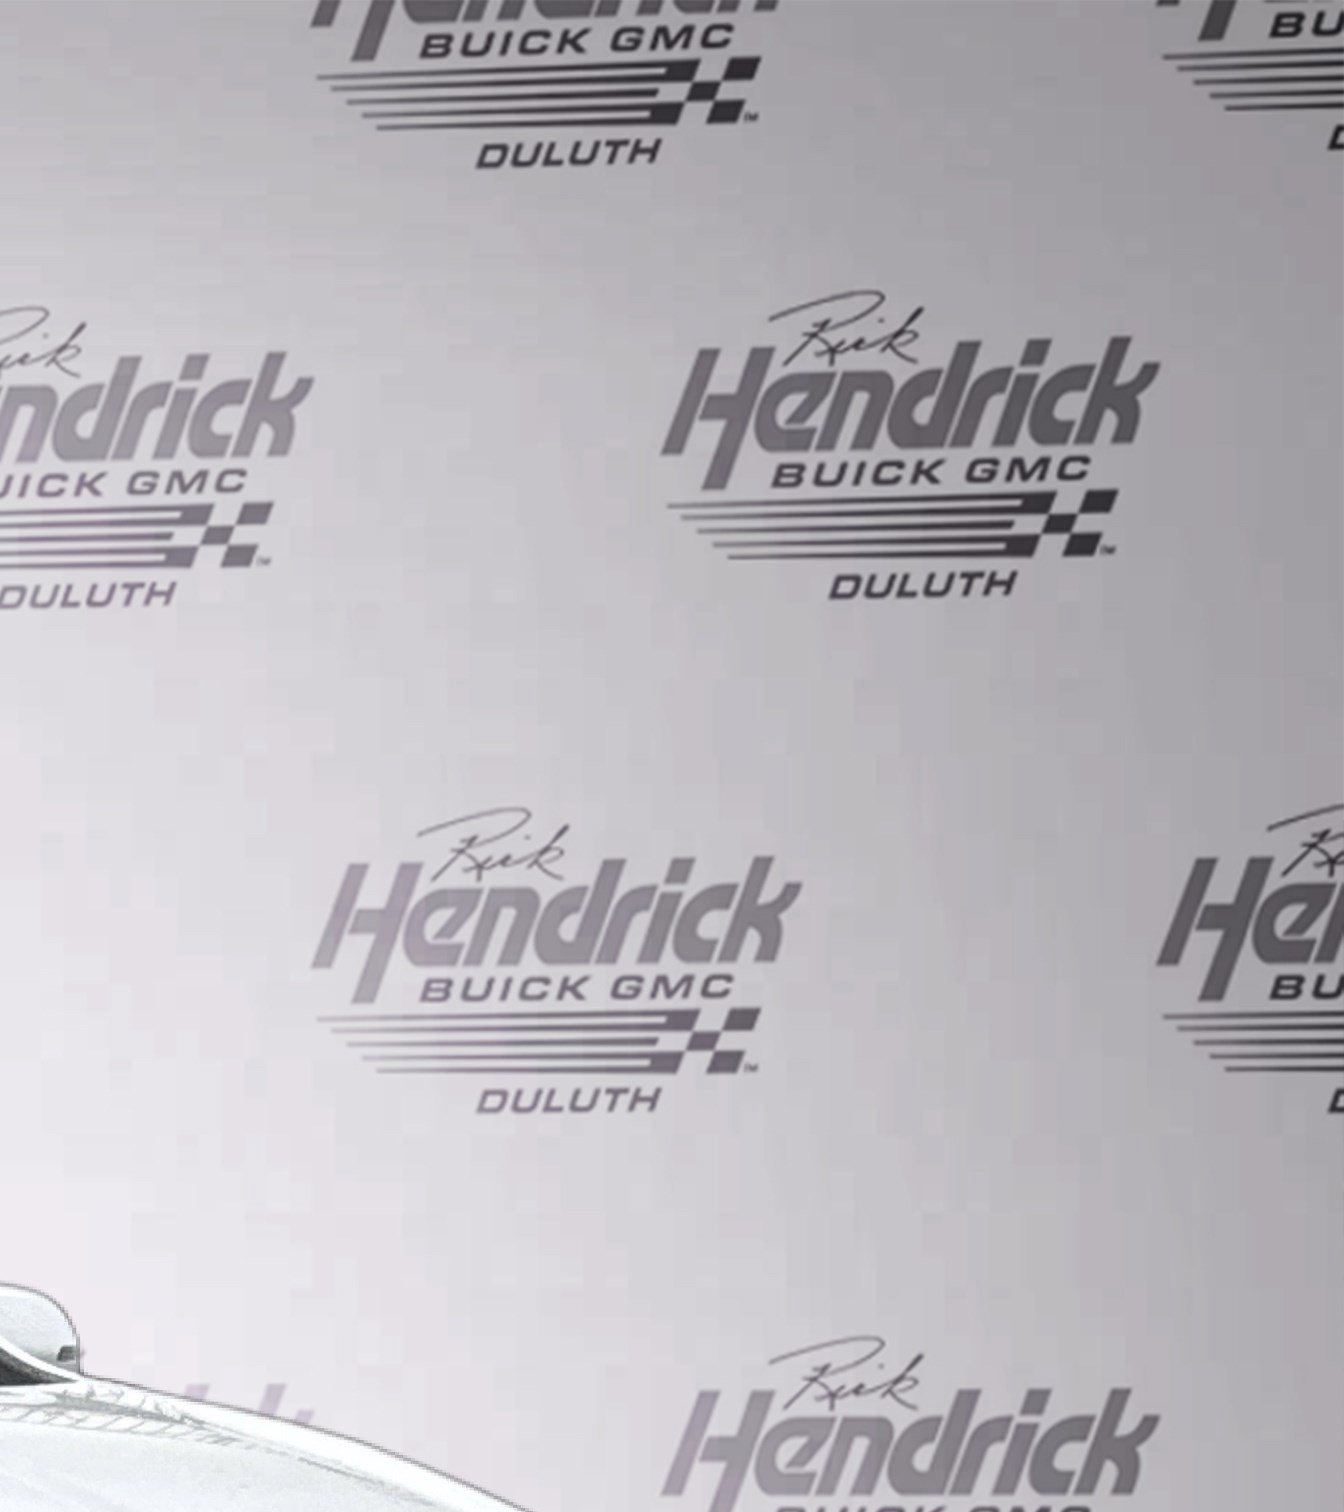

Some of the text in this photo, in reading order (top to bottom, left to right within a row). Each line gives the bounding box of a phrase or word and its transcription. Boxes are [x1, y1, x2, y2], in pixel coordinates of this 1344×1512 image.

[419, 27, 592, 59] BUICK
[610, 23, 735, 53] GMC
[475, 138, 662, 170] DULUTH
[660, 336, 1161, 491] Hendrick
[125, 467, 248, 497] GMC
[770, 454, 1092, 489] BUICK GMC
[828, 570, 1019, 601] DULUTH
[311, 855, 803, 1004] Hendrick
[418, 973, 735, 1003] BUICK GMC
[476, 1086, 663, 1114] DULUTH
